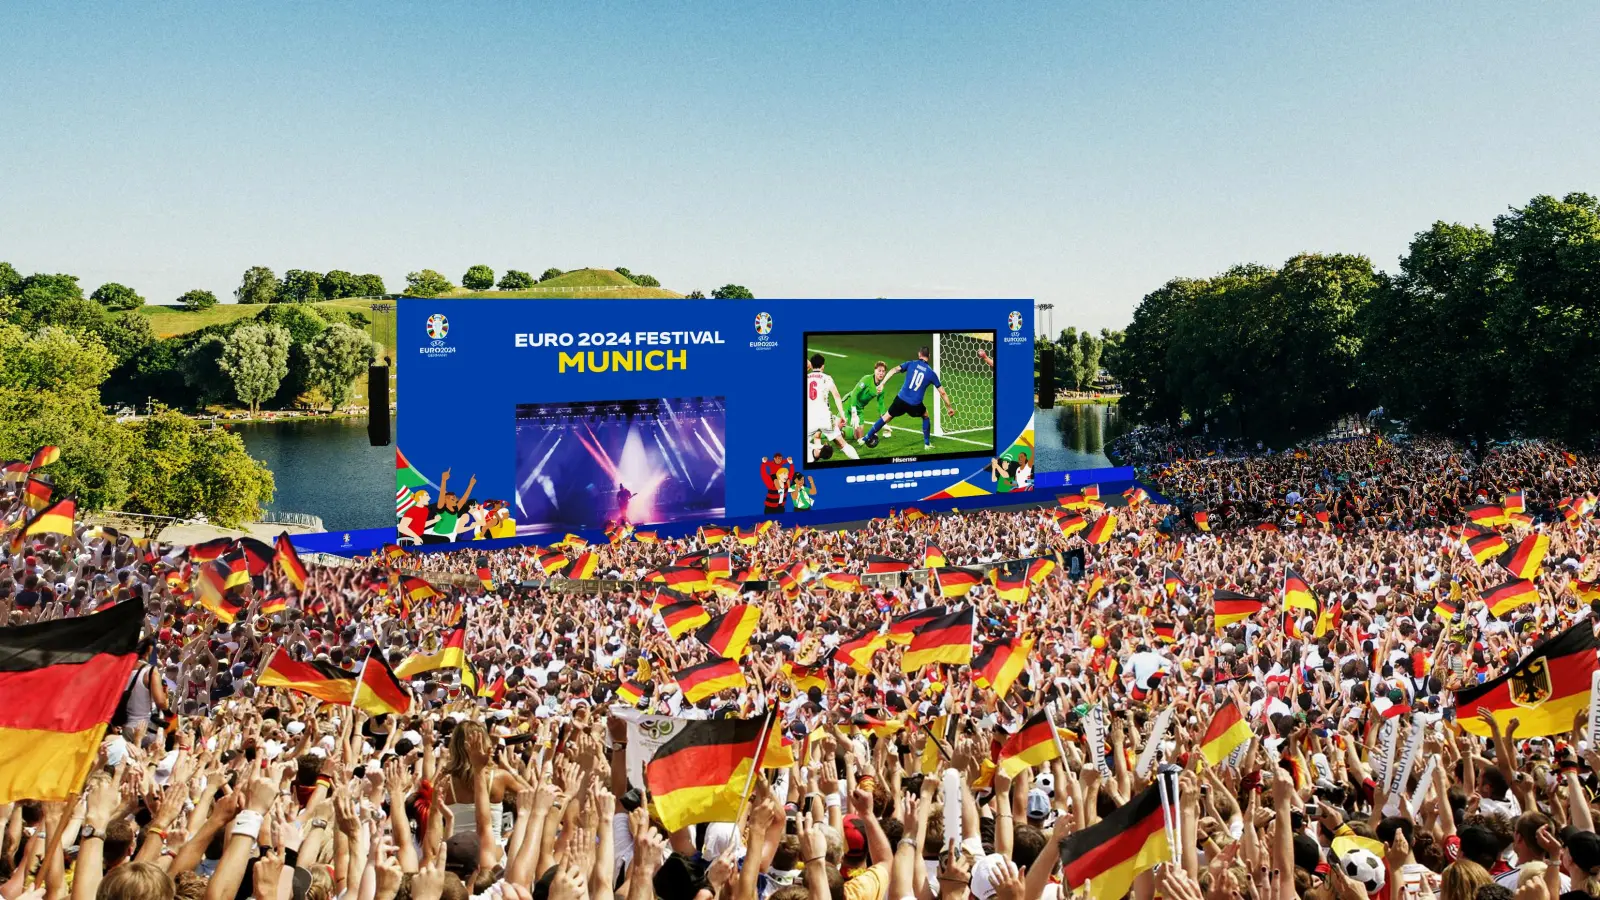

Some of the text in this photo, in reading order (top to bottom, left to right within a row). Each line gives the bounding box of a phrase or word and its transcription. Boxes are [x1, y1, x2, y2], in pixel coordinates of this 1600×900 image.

[515, 331, 725, 347] EURO 2024 FESTIVAL
[558, 349, 687, 373] MUNICH
[809, 381, 817, 400] 6
[909, 369, 924, 391] 19
[1391, 740, 1414, 794] HYUNDAI
